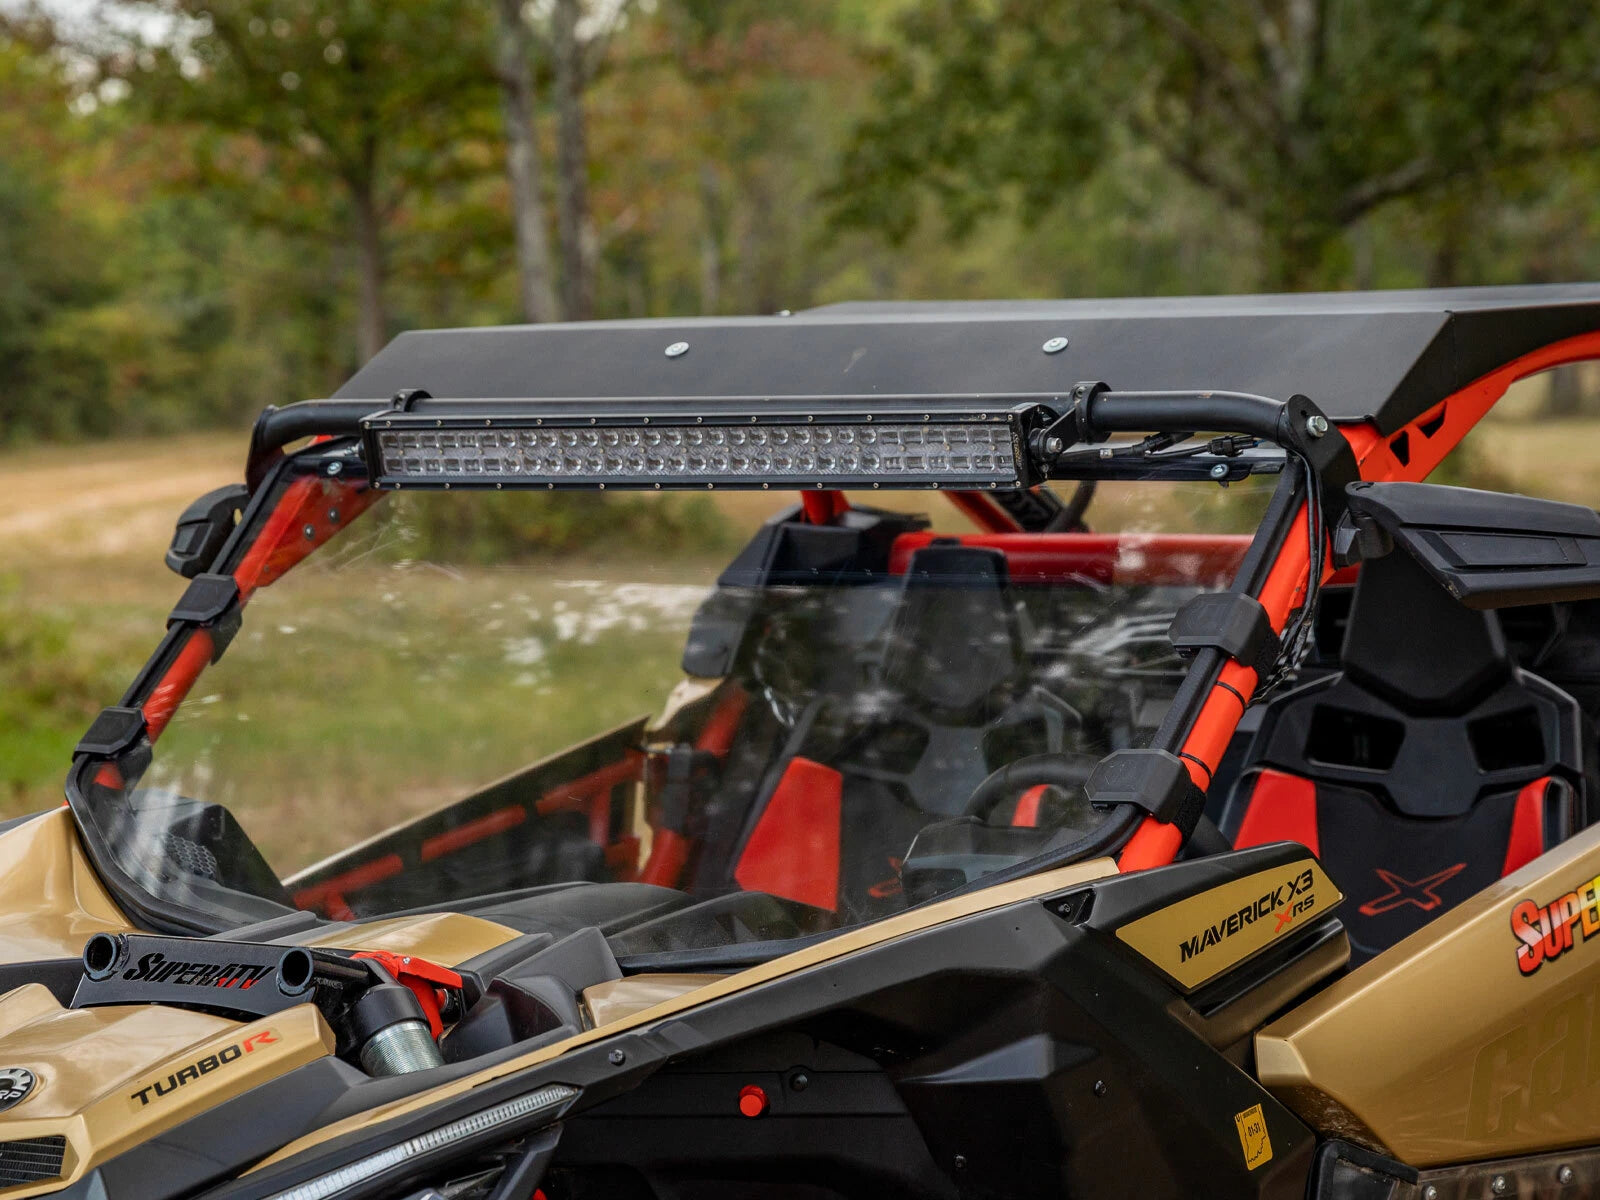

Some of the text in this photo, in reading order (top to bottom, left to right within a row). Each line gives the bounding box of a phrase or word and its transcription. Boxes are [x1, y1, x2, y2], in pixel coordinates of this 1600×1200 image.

[1179, 868, 1314, 963] MAVERICK X3
[1511, 874, 1600, 977] SUPE
[131, 1044, 242, 1106] TURBO
